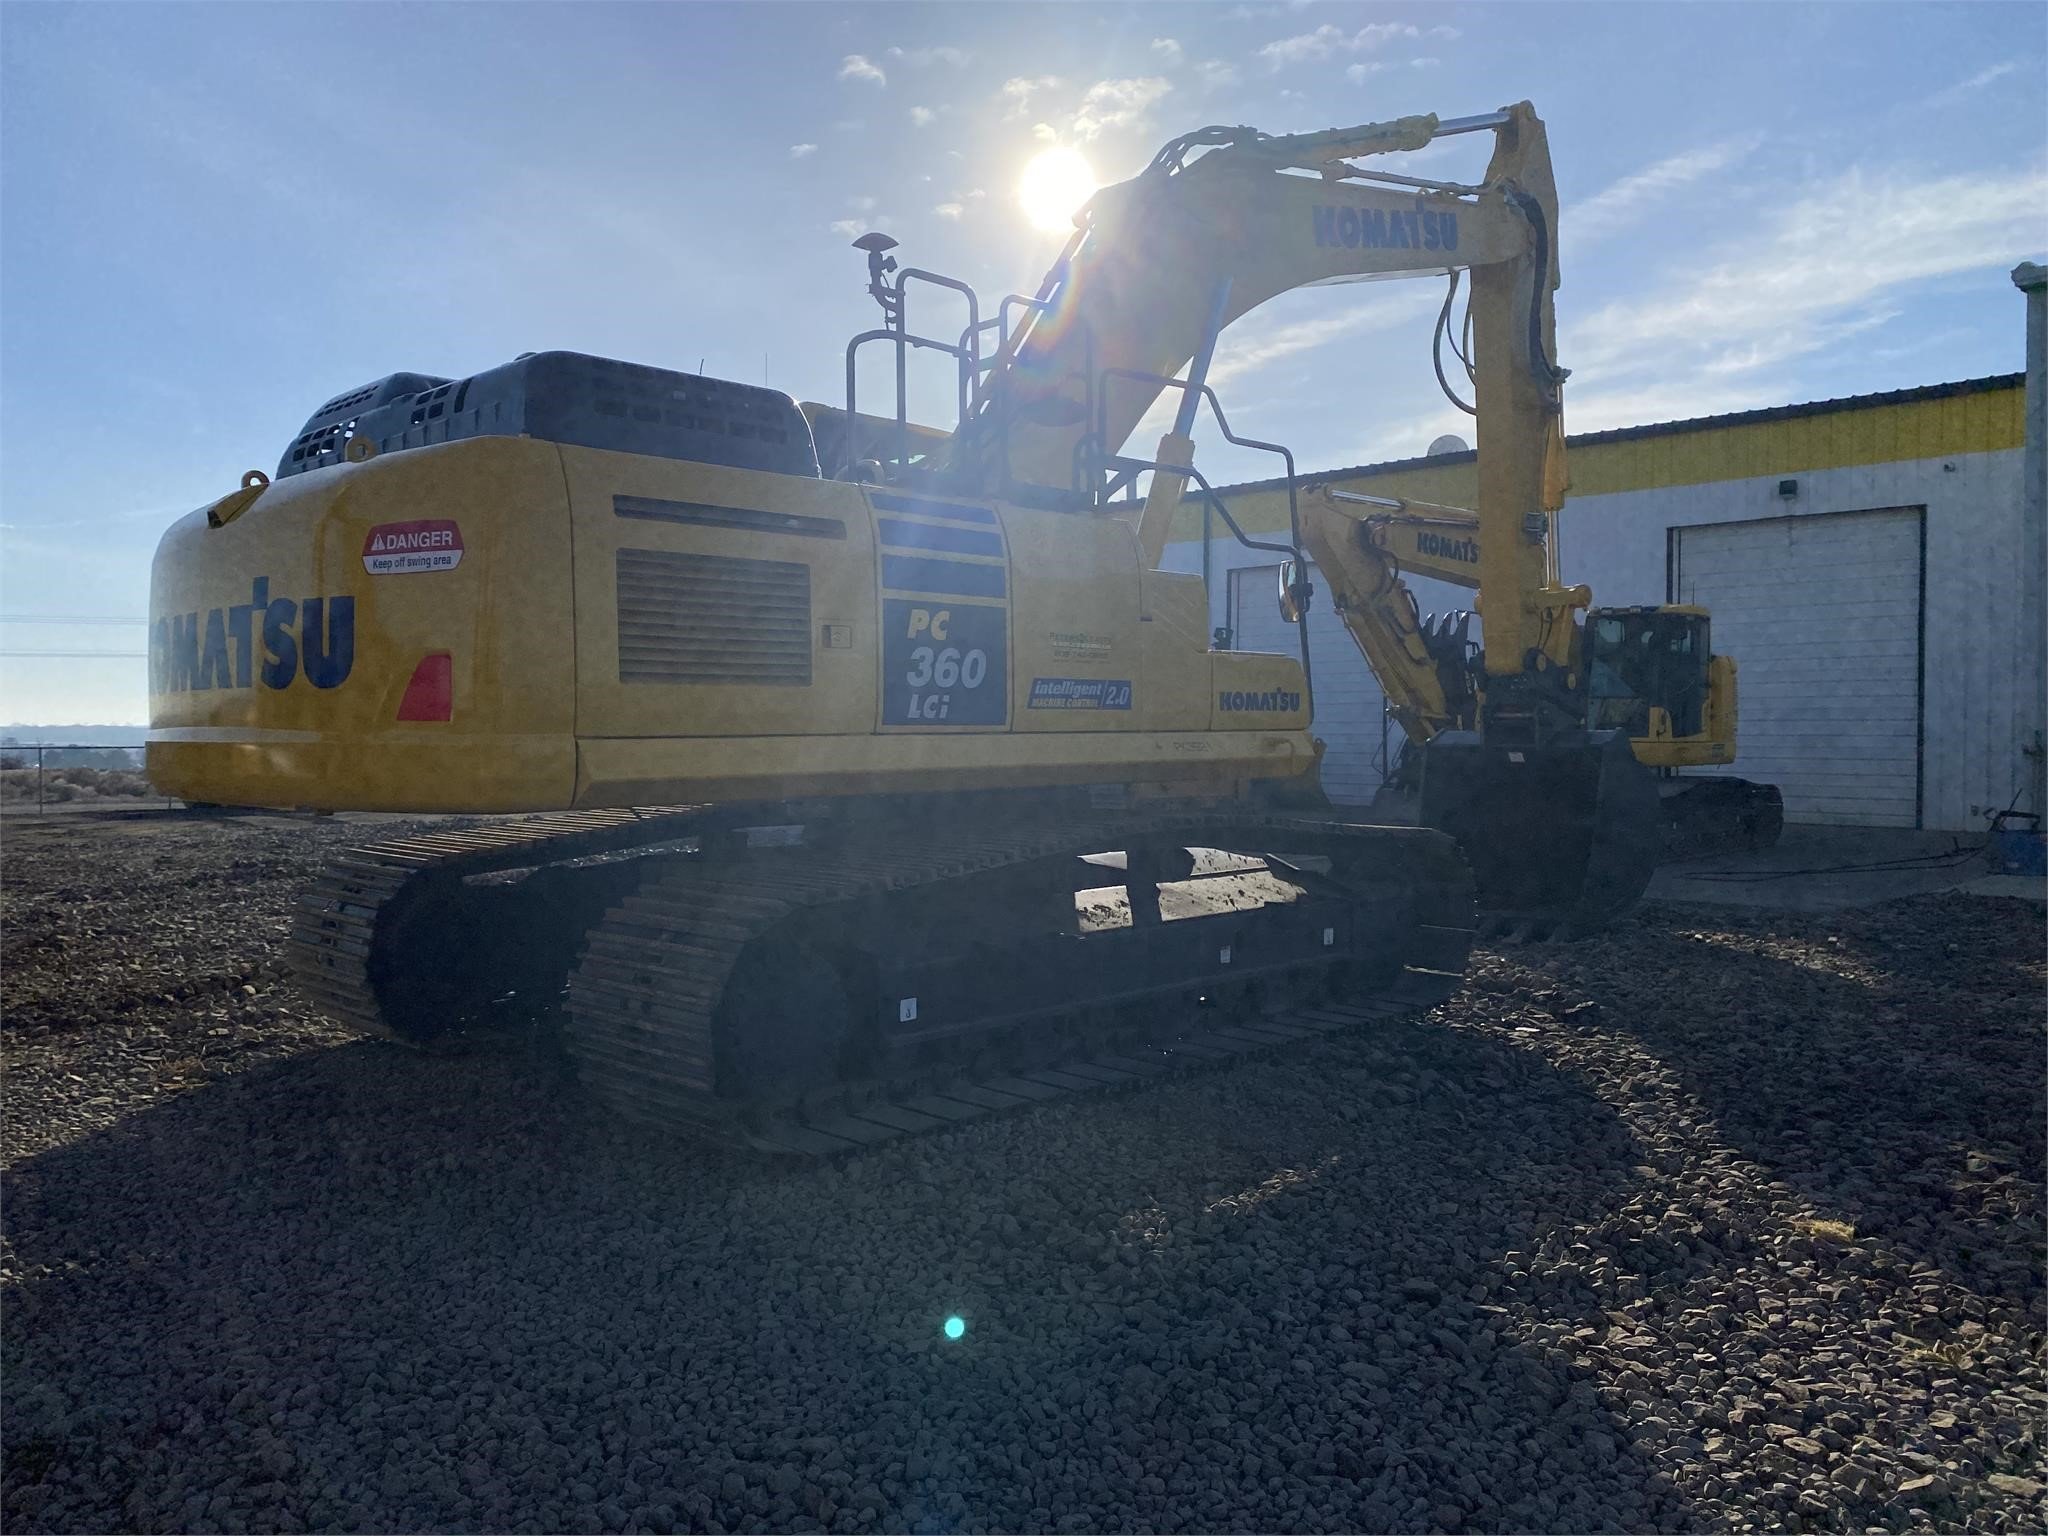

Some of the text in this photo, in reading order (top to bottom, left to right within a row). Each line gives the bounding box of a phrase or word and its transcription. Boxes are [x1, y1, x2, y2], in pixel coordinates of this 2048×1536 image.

[1312, 199, 1457, 251] KOMATSU
[386, 531, 453, 549] DANGER
[1417, 532, 1480, 563] KOMATS
[373, 555, 452, 572] Keep off swing area
[150, 576, 355, 690] OMATSU
[907, 608, 950, 640] PC
[906, 646, 987, 689] 360
[907, 694, 950, 719] LCi
[1035, 680, 1130, 705] intelligent 2.0
[1219, 687, 1300, 711] KOMATSU
